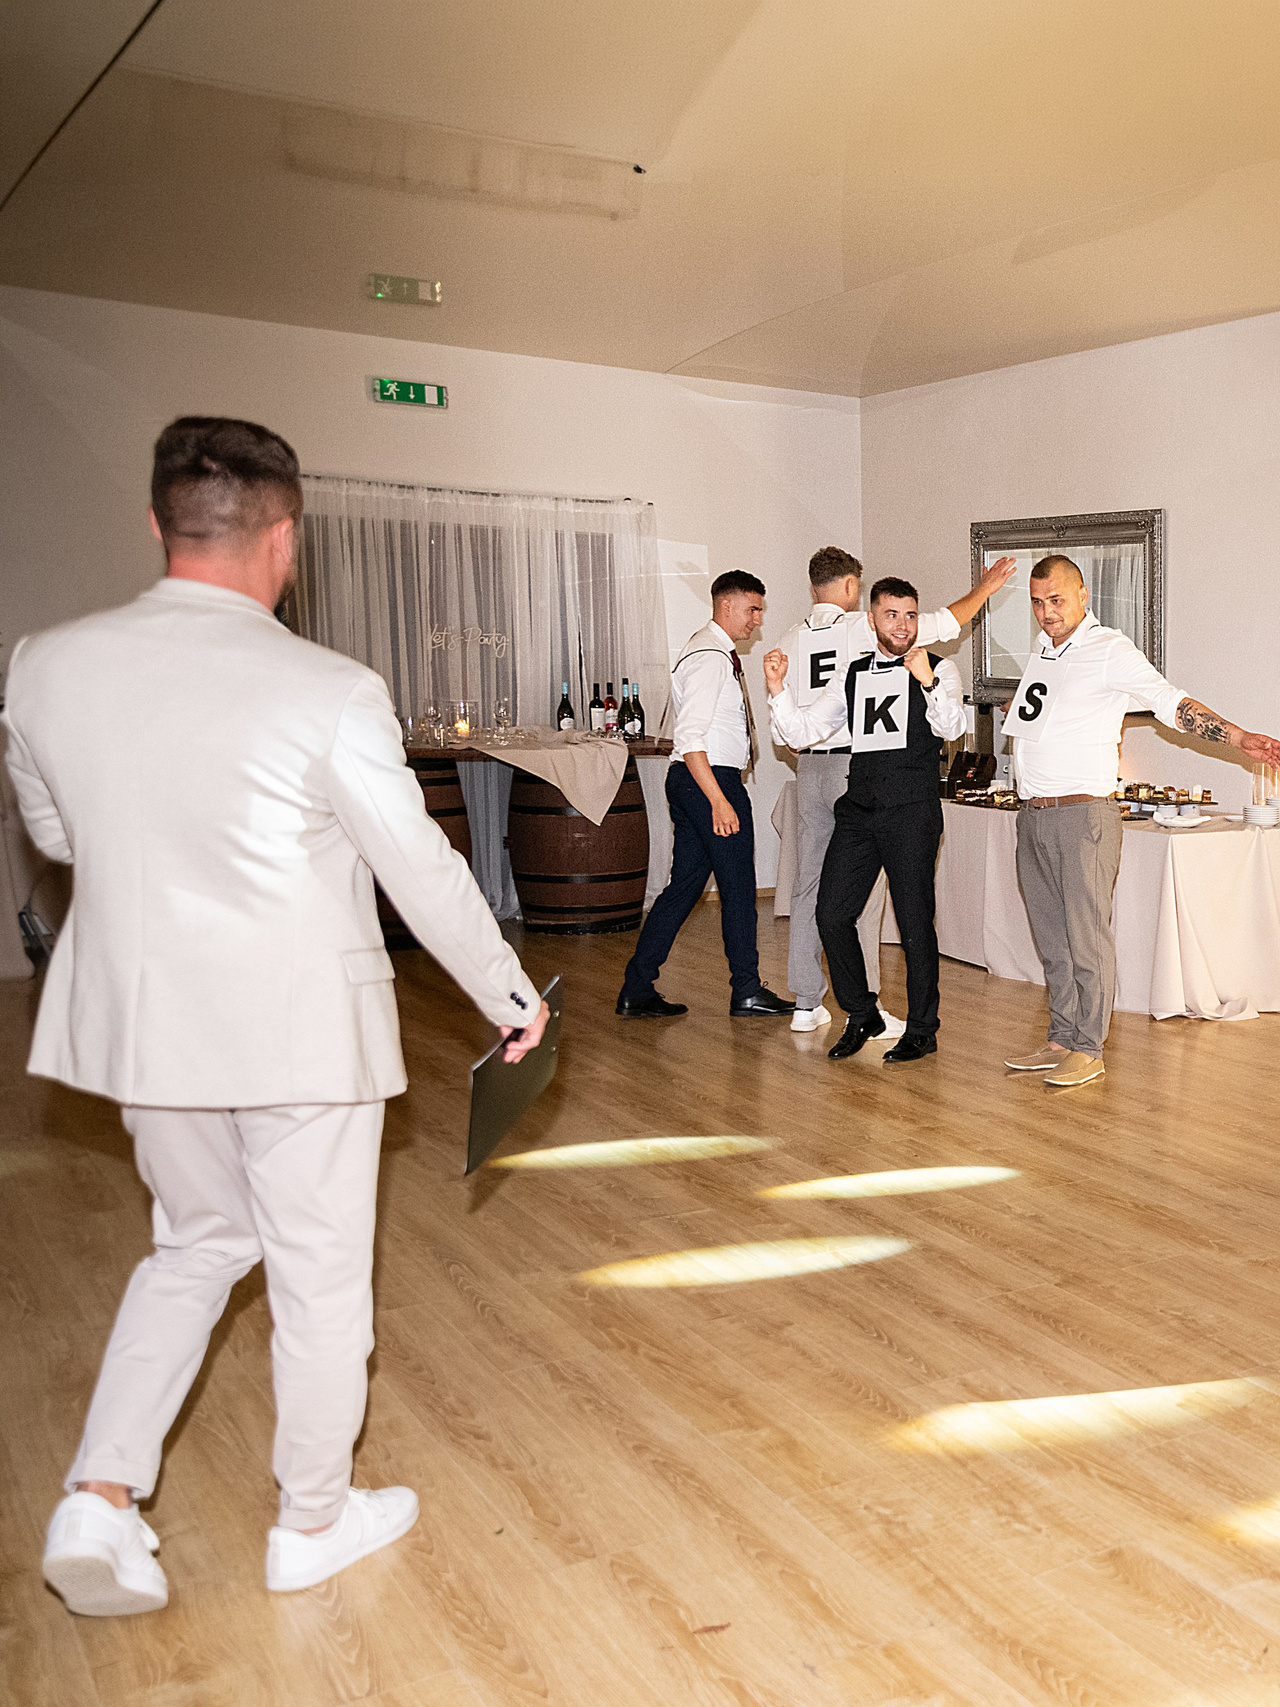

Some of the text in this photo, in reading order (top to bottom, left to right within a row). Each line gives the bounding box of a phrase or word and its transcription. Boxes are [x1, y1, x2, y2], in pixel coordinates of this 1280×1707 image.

[810, 650, 837, 690] E
[863, 694, 901, 735] K
[1018, 682, 1048, 722] S
